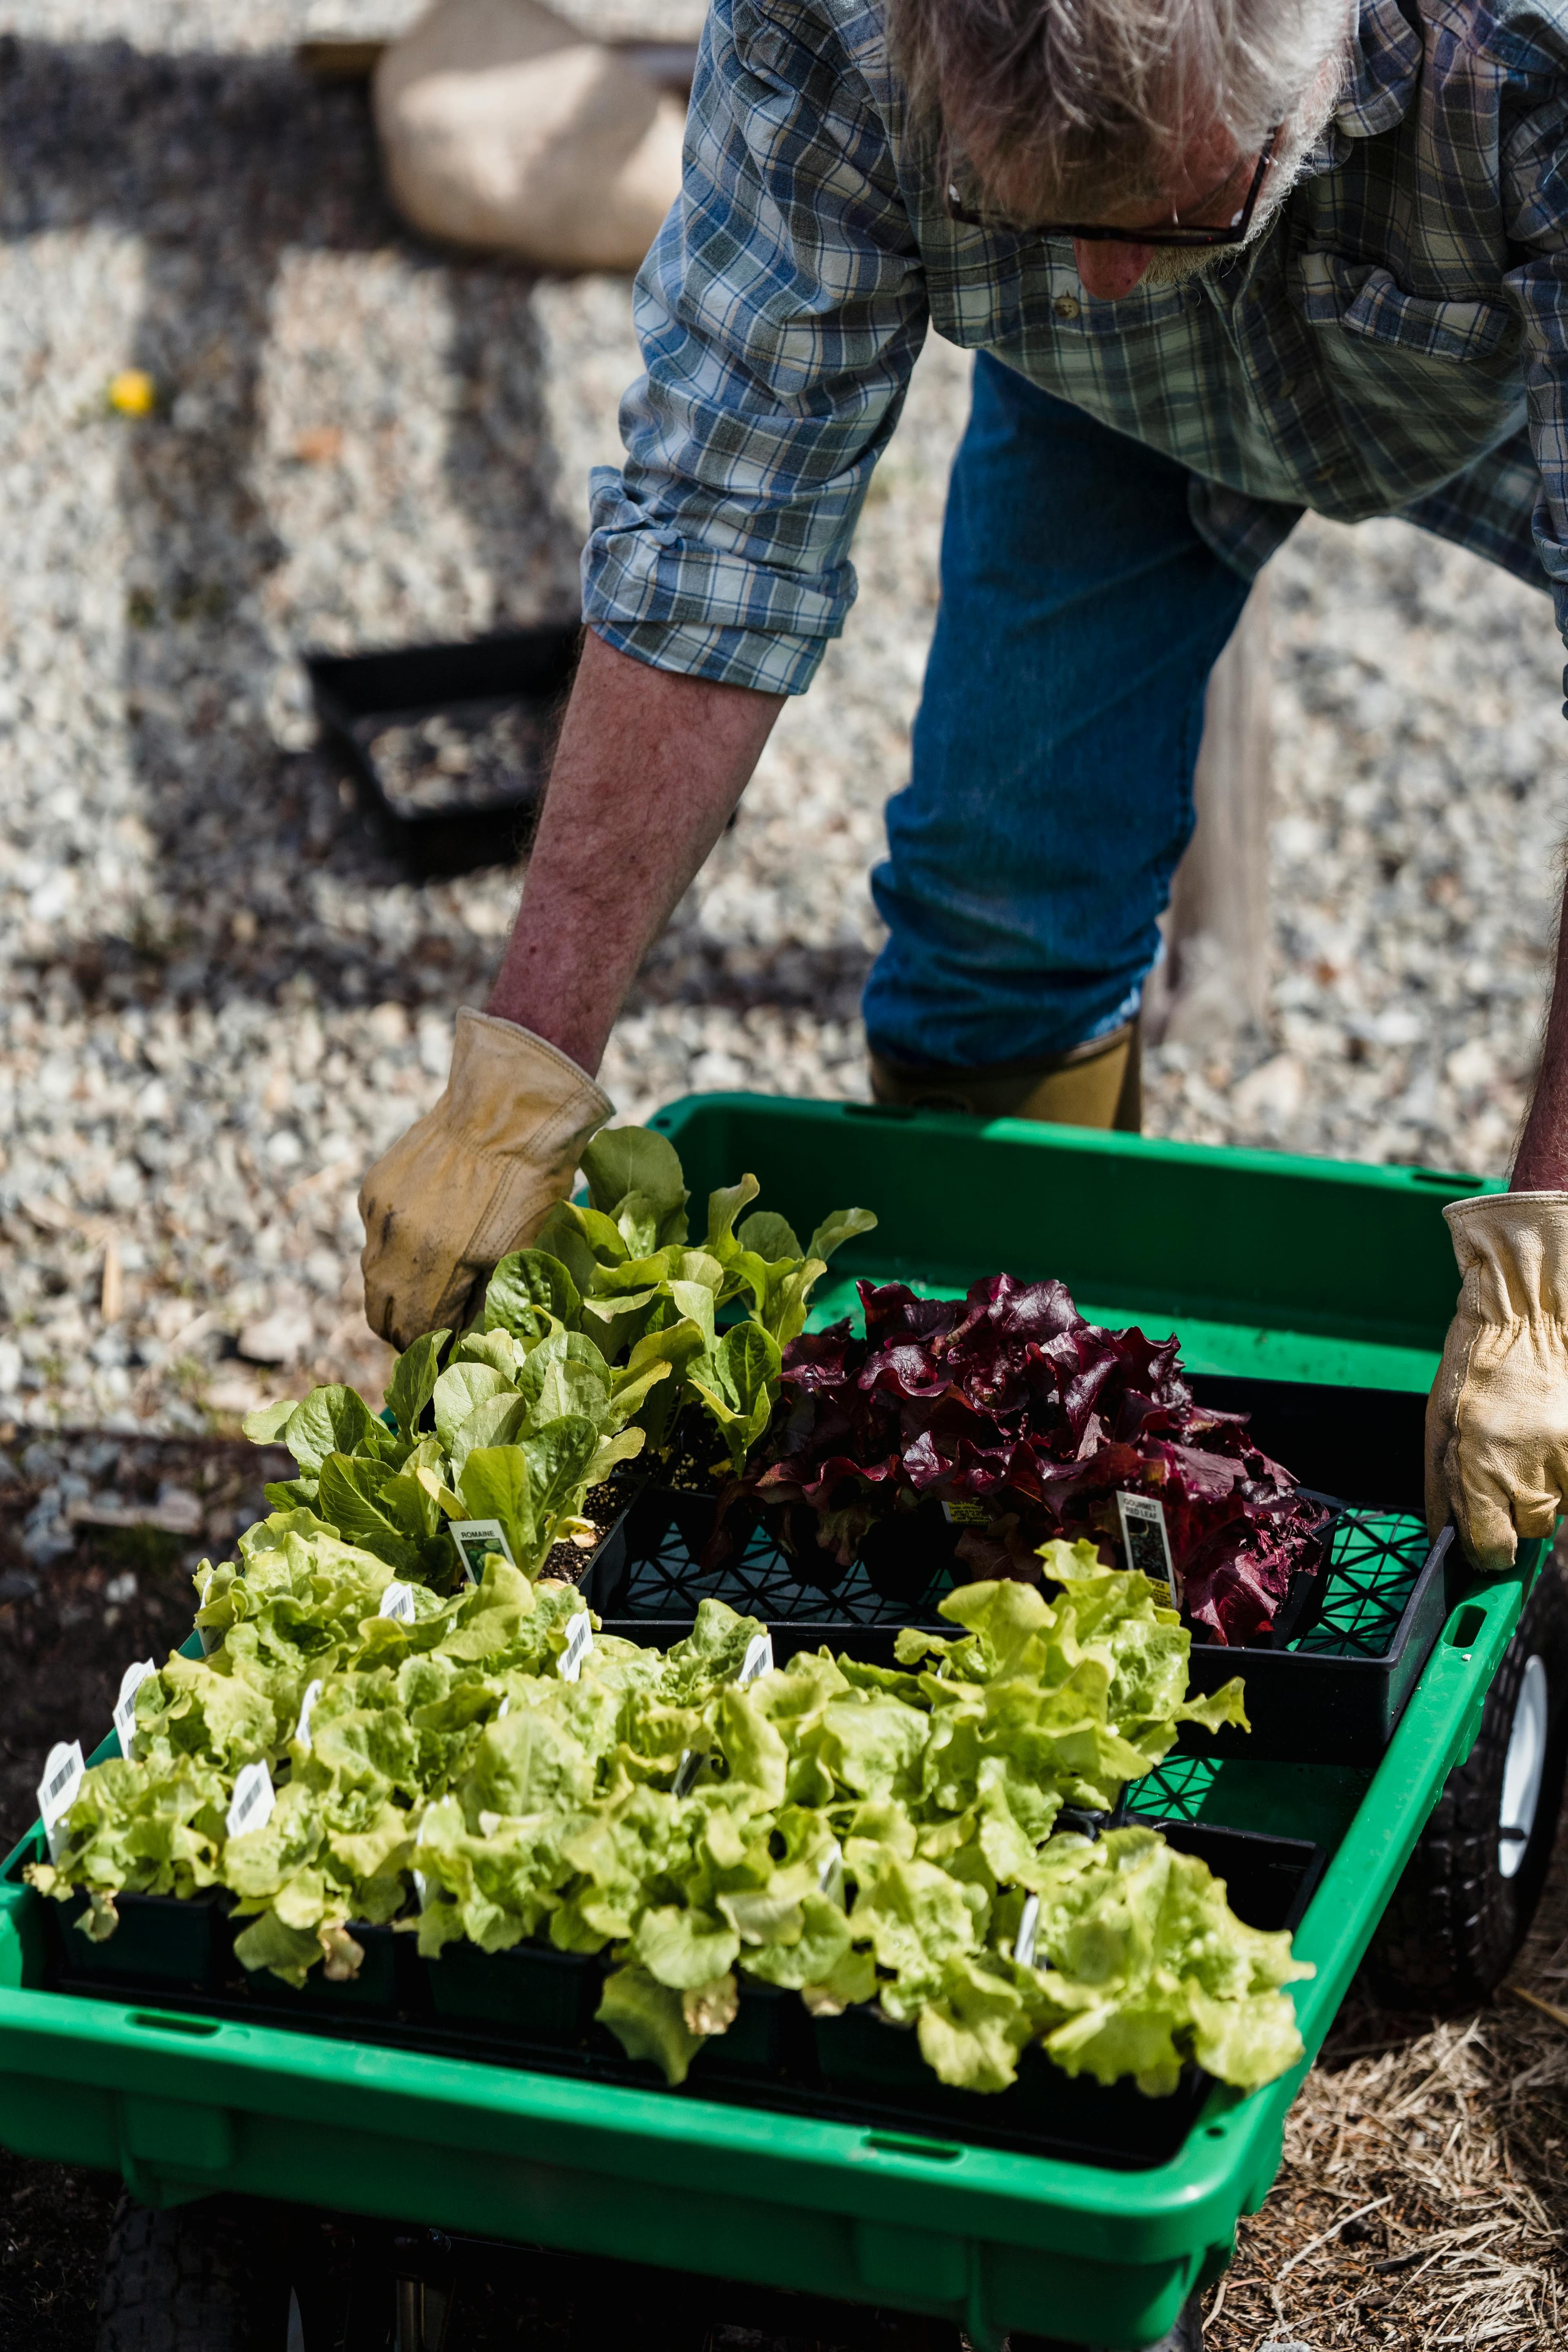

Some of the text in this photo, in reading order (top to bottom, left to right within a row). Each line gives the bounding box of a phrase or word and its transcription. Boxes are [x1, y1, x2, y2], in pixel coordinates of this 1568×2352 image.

[1124, 1498, 1156, 1512] GOURMET
[1126, 1506, 1157, 1519] RED LEAF
